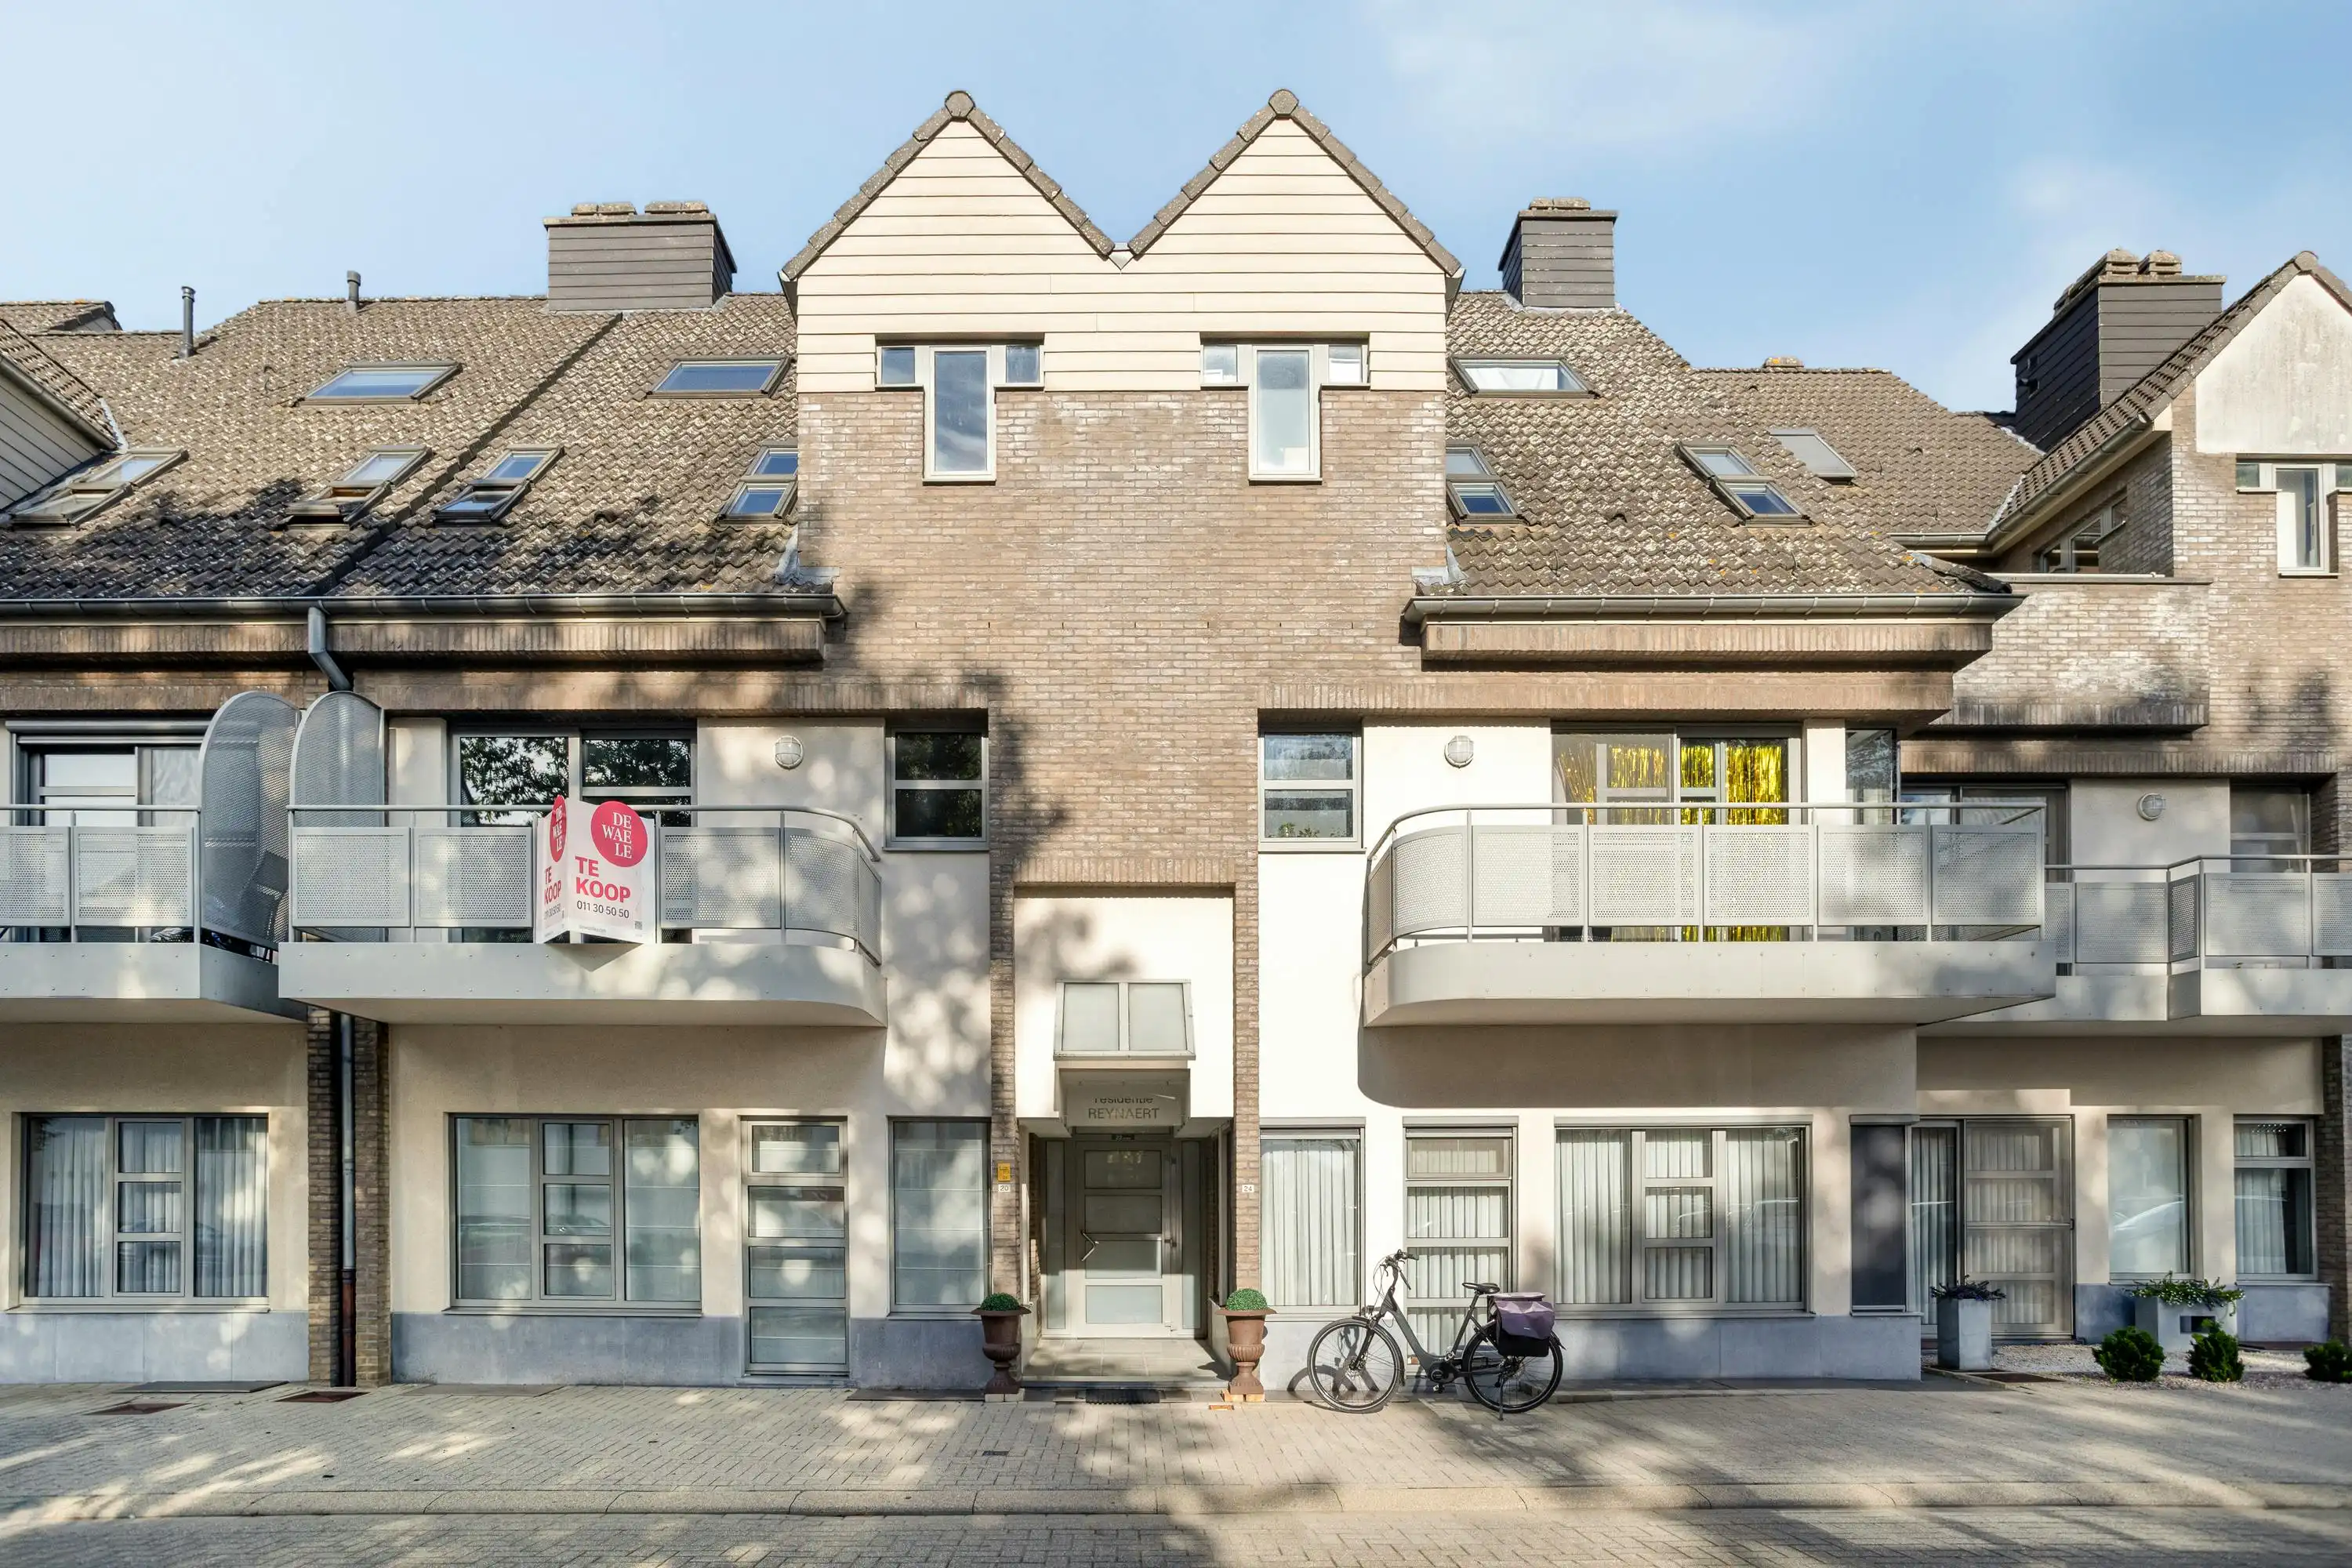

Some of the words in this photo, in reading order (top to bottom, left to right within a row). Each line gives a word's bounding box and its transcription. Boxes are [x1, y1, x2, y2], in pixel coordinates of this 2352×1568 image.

[556, 805, 562, 822] DE
[612, 811, 632, 829] DE
[553, 820, 563, 840] WAE
[602, 825, 632, 844] WAE
[556, 835, 563, 852] LE
[615, 843, 633, 859] LE
[544, 866, 552, 884] TE
[575, 856, 600, 877] TE
[544, 880, 562, 905] KOOP
[576, 877, 630, 903] KOOP
[576, 900, 590, 911] 011
[593, 903, 604, 913] 30
[606, 906, 616, 916] 50
[619, 909, 630, 918] 50
[1088, 1108, 1160, 1119] REYNAERT
